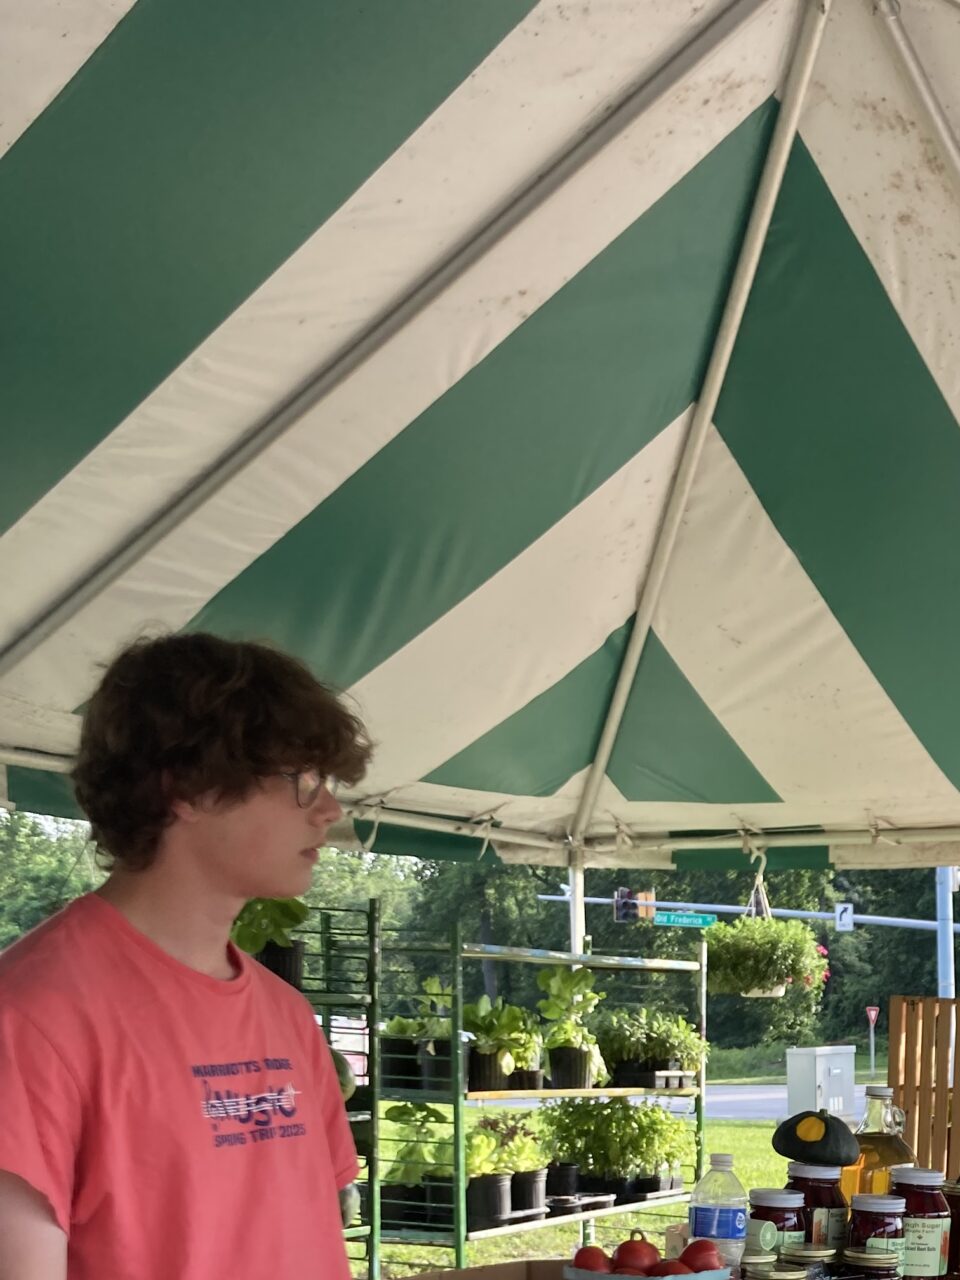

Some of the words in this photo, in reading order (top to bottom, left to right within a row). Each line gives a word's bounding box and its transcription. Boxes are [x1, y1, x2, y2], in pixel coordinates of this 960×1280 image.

[655, 913, 667, 924] Old
[670, 914, 703, 925] Frederick
[214, 1132, 247, 1147] SPRING
